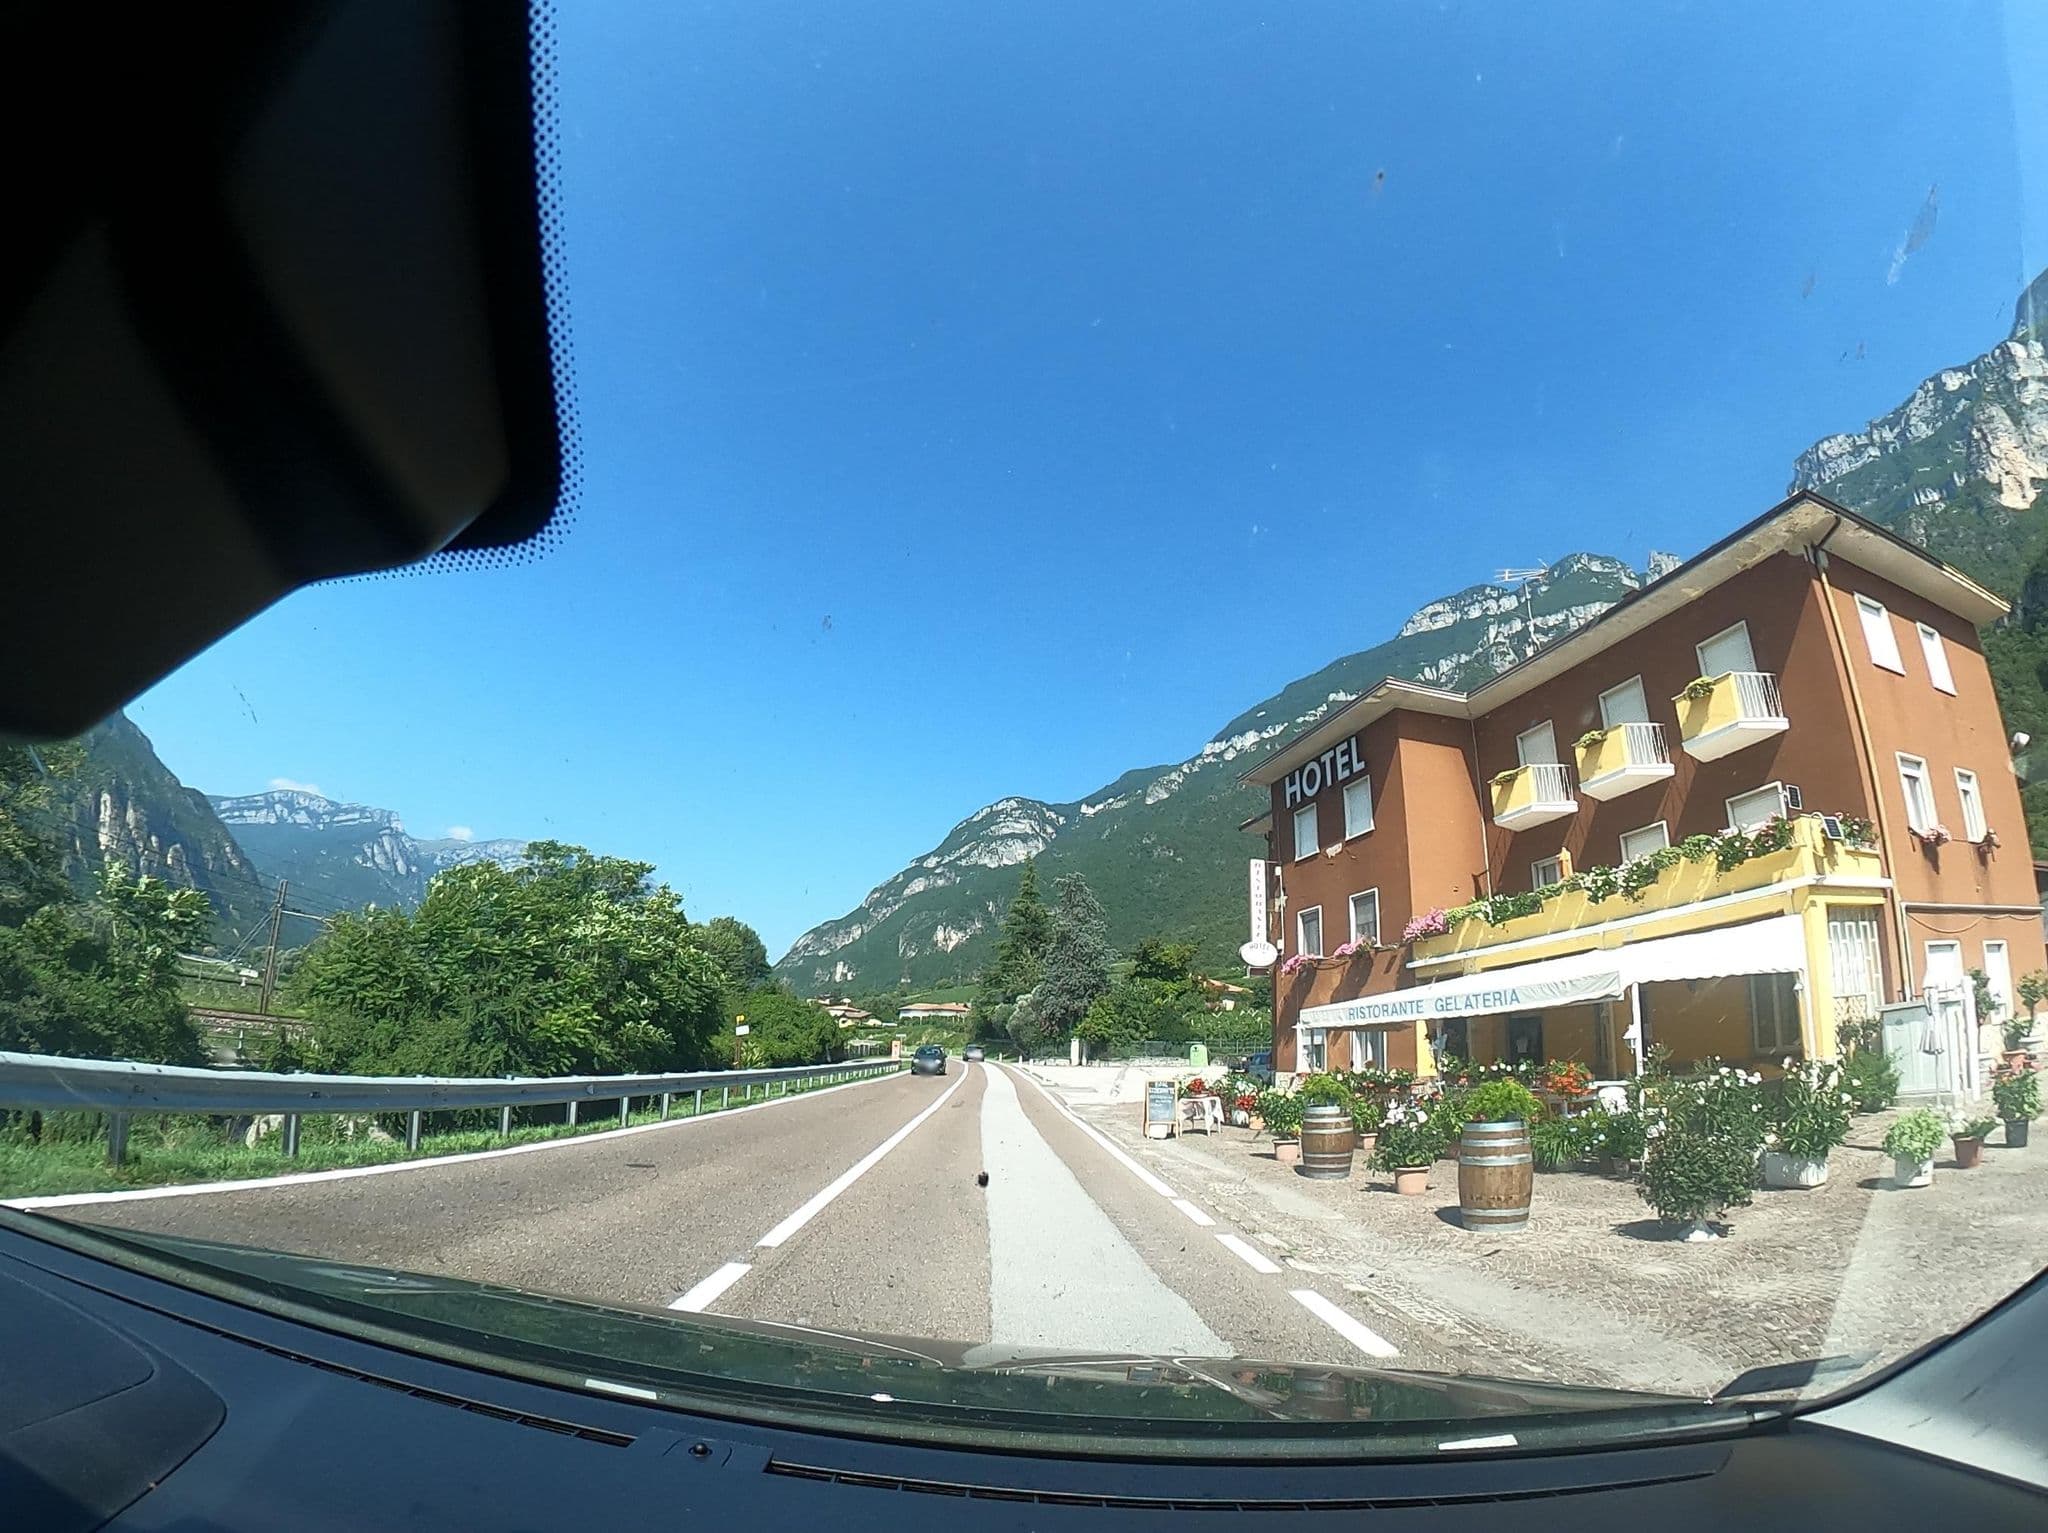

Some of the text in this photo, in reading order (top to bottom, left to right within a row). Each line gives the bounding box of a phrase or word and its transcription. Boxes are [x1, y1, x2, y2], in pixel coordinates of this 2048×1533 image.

[1284, 735, 1366, 809] HOTEL
[1254, 862, 1263, 938] RISORN
[1348, 989, 1521, 1021] RISTORANTE GELATERIA
